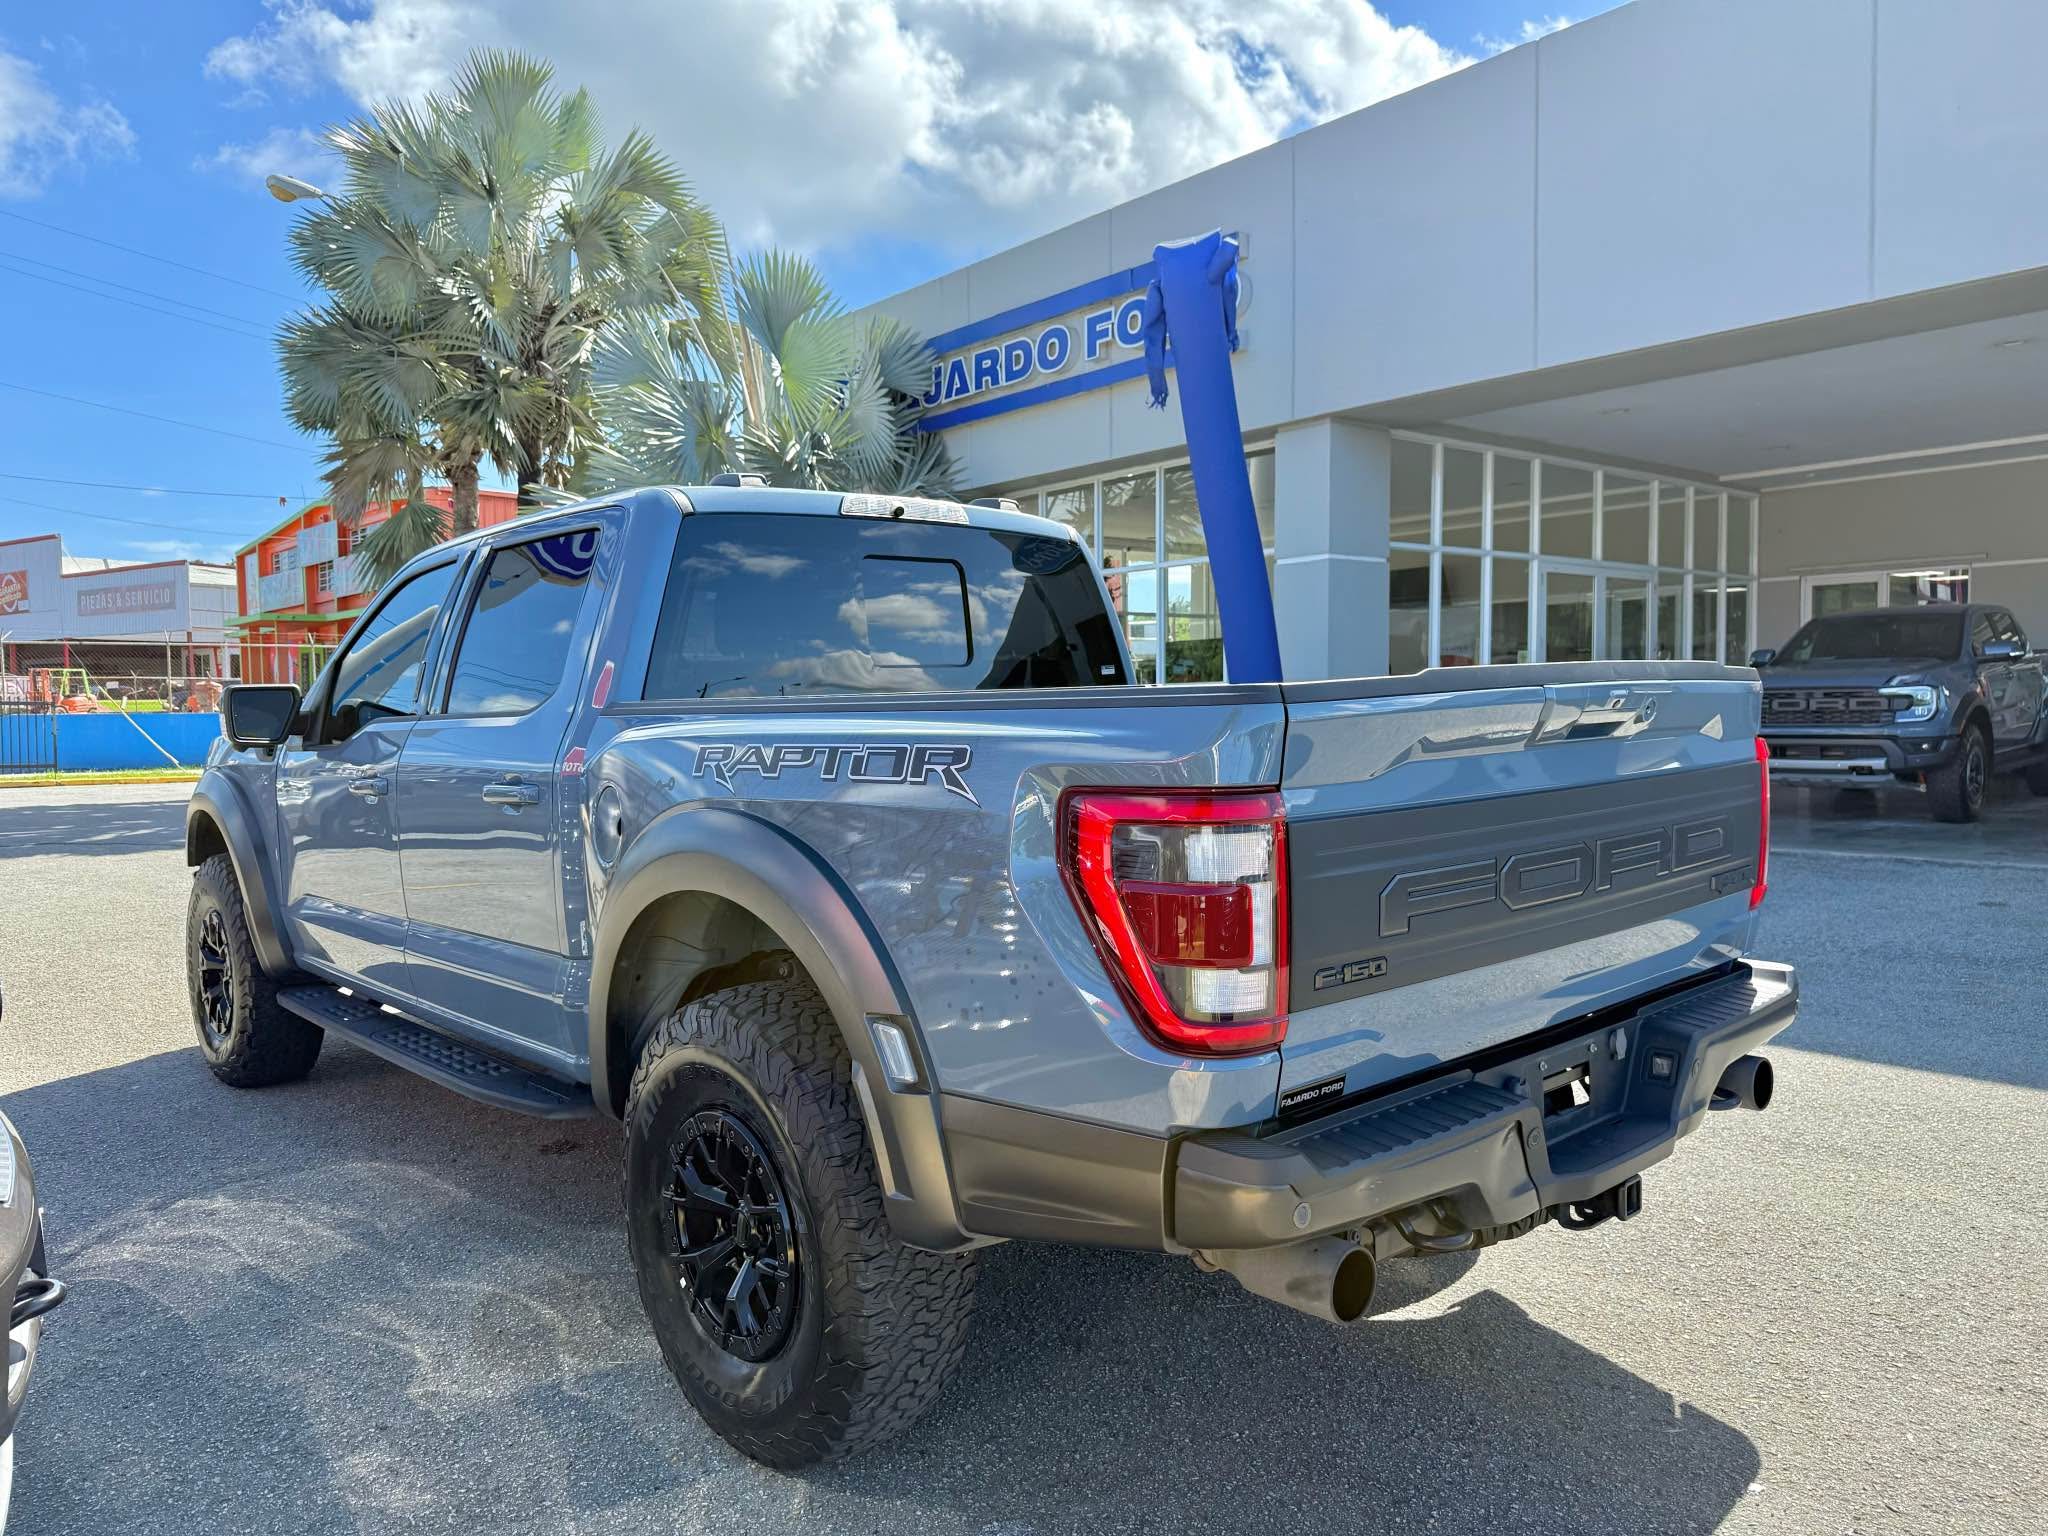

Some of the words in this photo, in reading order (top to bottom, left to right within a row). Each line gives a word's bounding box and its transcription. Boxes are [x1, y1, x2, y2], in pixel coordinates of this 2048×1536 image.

[905, 322, 1071, 410] JARDO
[80, 591, 113, 609] PIEZAS
[125, 588, 170, 607] SERVICIO
[1771, 697, 1889, 713] ORD
[692, 744, 981, 808] RAPTOR
[1378, 815, 1732, 937] FORD
[1313, 955, 1388, 991] F-150
[1280, 1090, 1319, 1108] FAJARDO
[1321, 1081, 1344, 1095] FORD
